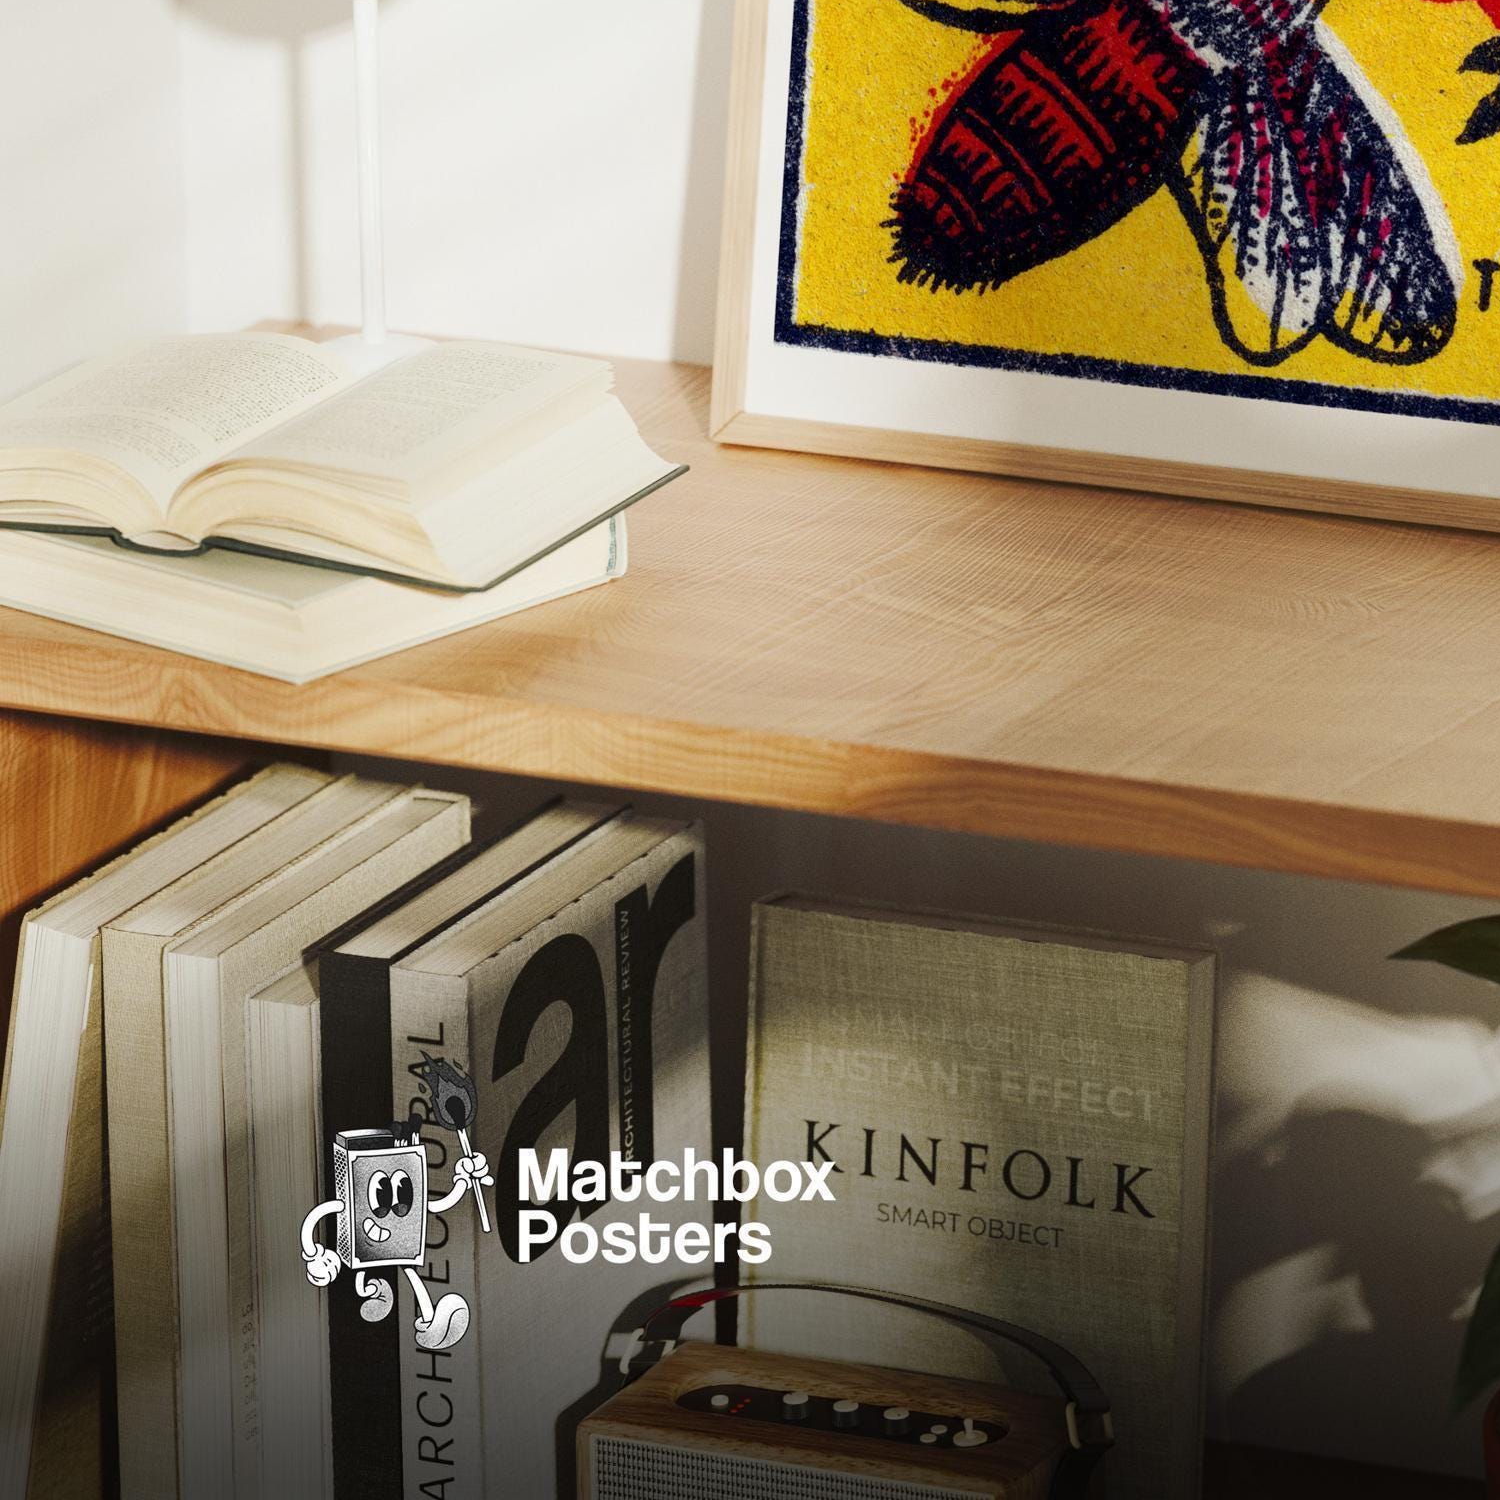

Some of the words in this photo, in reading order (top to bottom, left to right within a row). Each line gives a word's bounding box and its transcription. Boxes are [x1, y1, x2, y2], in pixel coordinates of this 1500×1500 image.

[620, 910, 631, 990] REVIEW
[622, 997, 635, 1175] RCHITECTURAL
[998, 1067, 1163, 1124] EFFECT
[803, 1119, 1157, 1219] KINFOLK
[876, 1202, 962, 1233] SMART
[966, 1215, 1065, 1248] OBJECT
